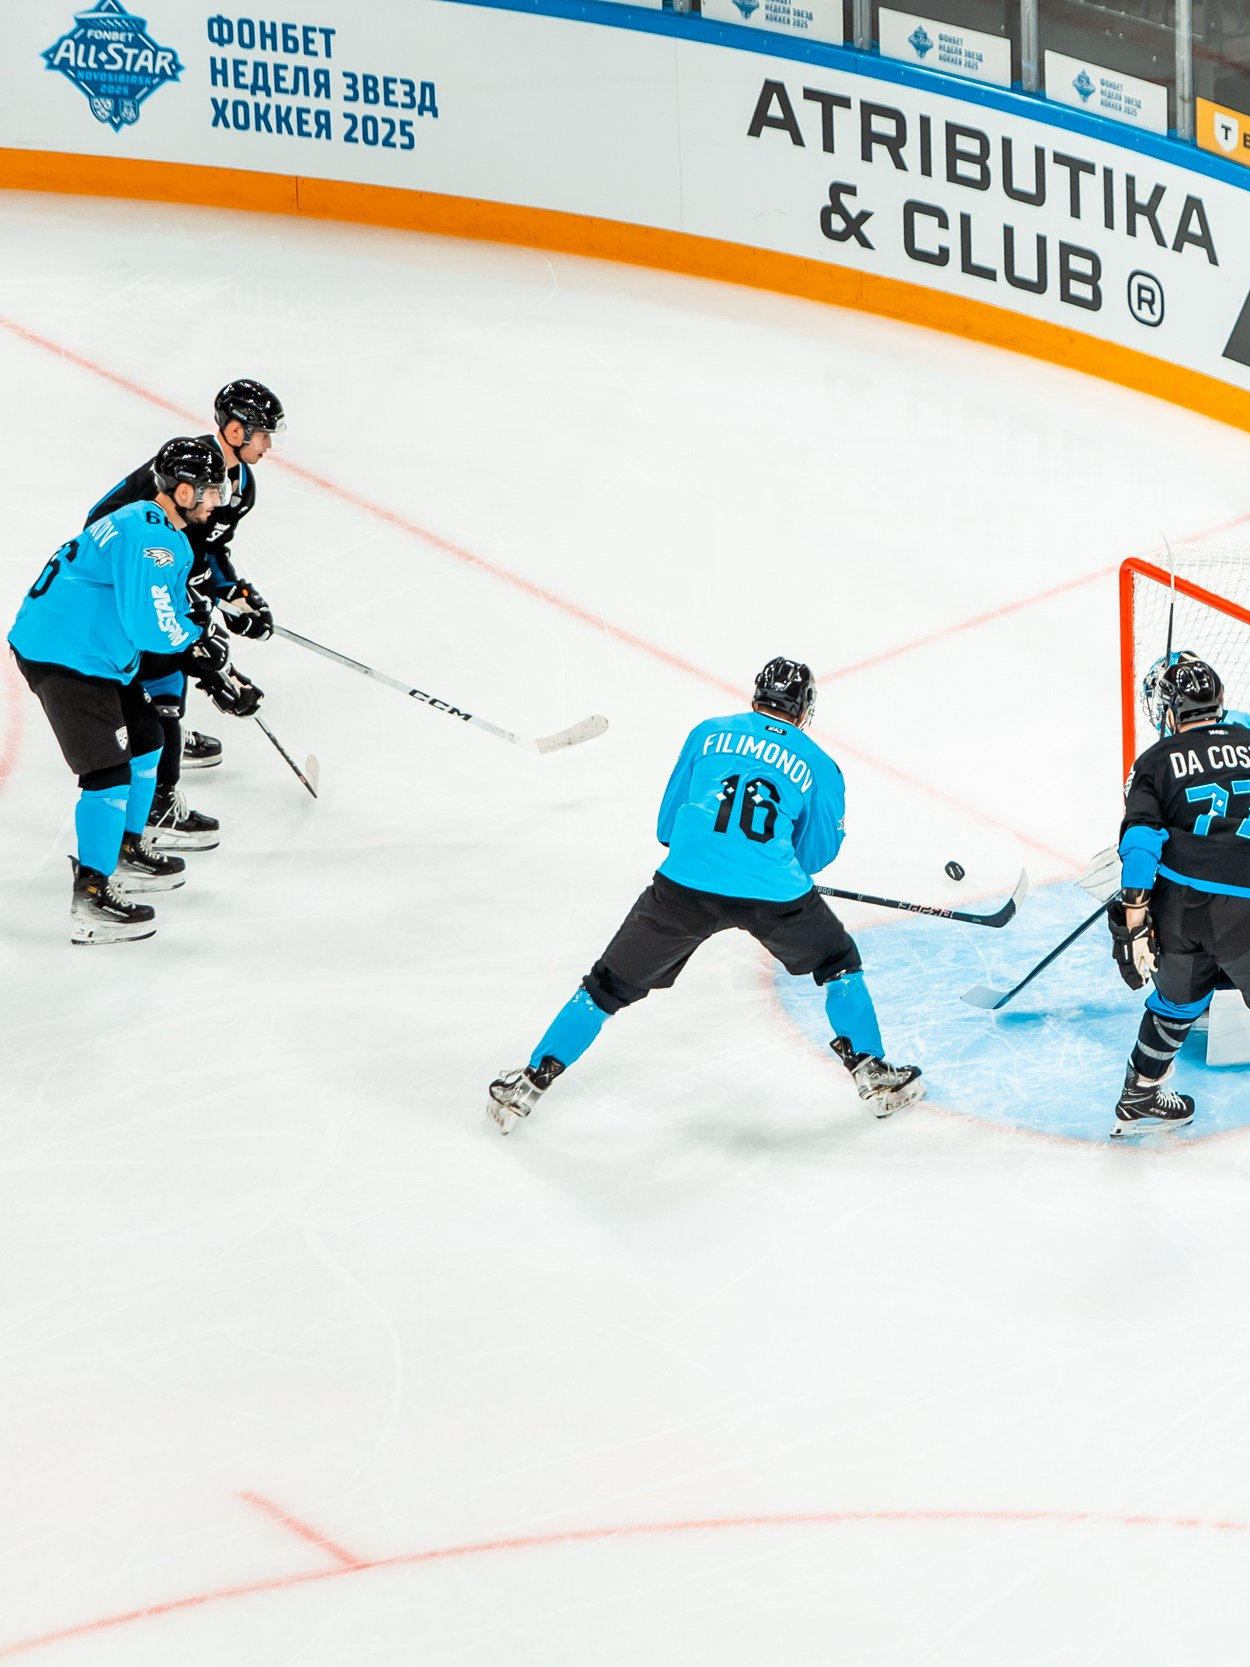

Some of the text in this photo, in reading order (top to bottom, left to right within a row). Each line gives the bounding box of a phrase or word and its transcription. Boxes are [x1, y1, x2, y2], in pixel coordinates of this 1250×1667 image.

[86, 29, 135, 43] FONBET
[207, 14, 336, 58] ФОНБЕТ
[209, 56, 439, 118] НЕДЕЛЯ ЗВЕЗД
[210, 97, 416, 150] ХОККЕЯ 2025
[746, 78, 1219, 267] ATRIBUTIKA
[819, 180, 876, 250] &
[903, 199, 1103, 312] CLUB
[408, 689, 473, 721] CCM
[702, 732, 813, 793] FILIMONOV
[1169, 750, 1204, 779] DA
[714, 774, 781, 844] 16
[1149, 1107, 1168, 1116] CCM
